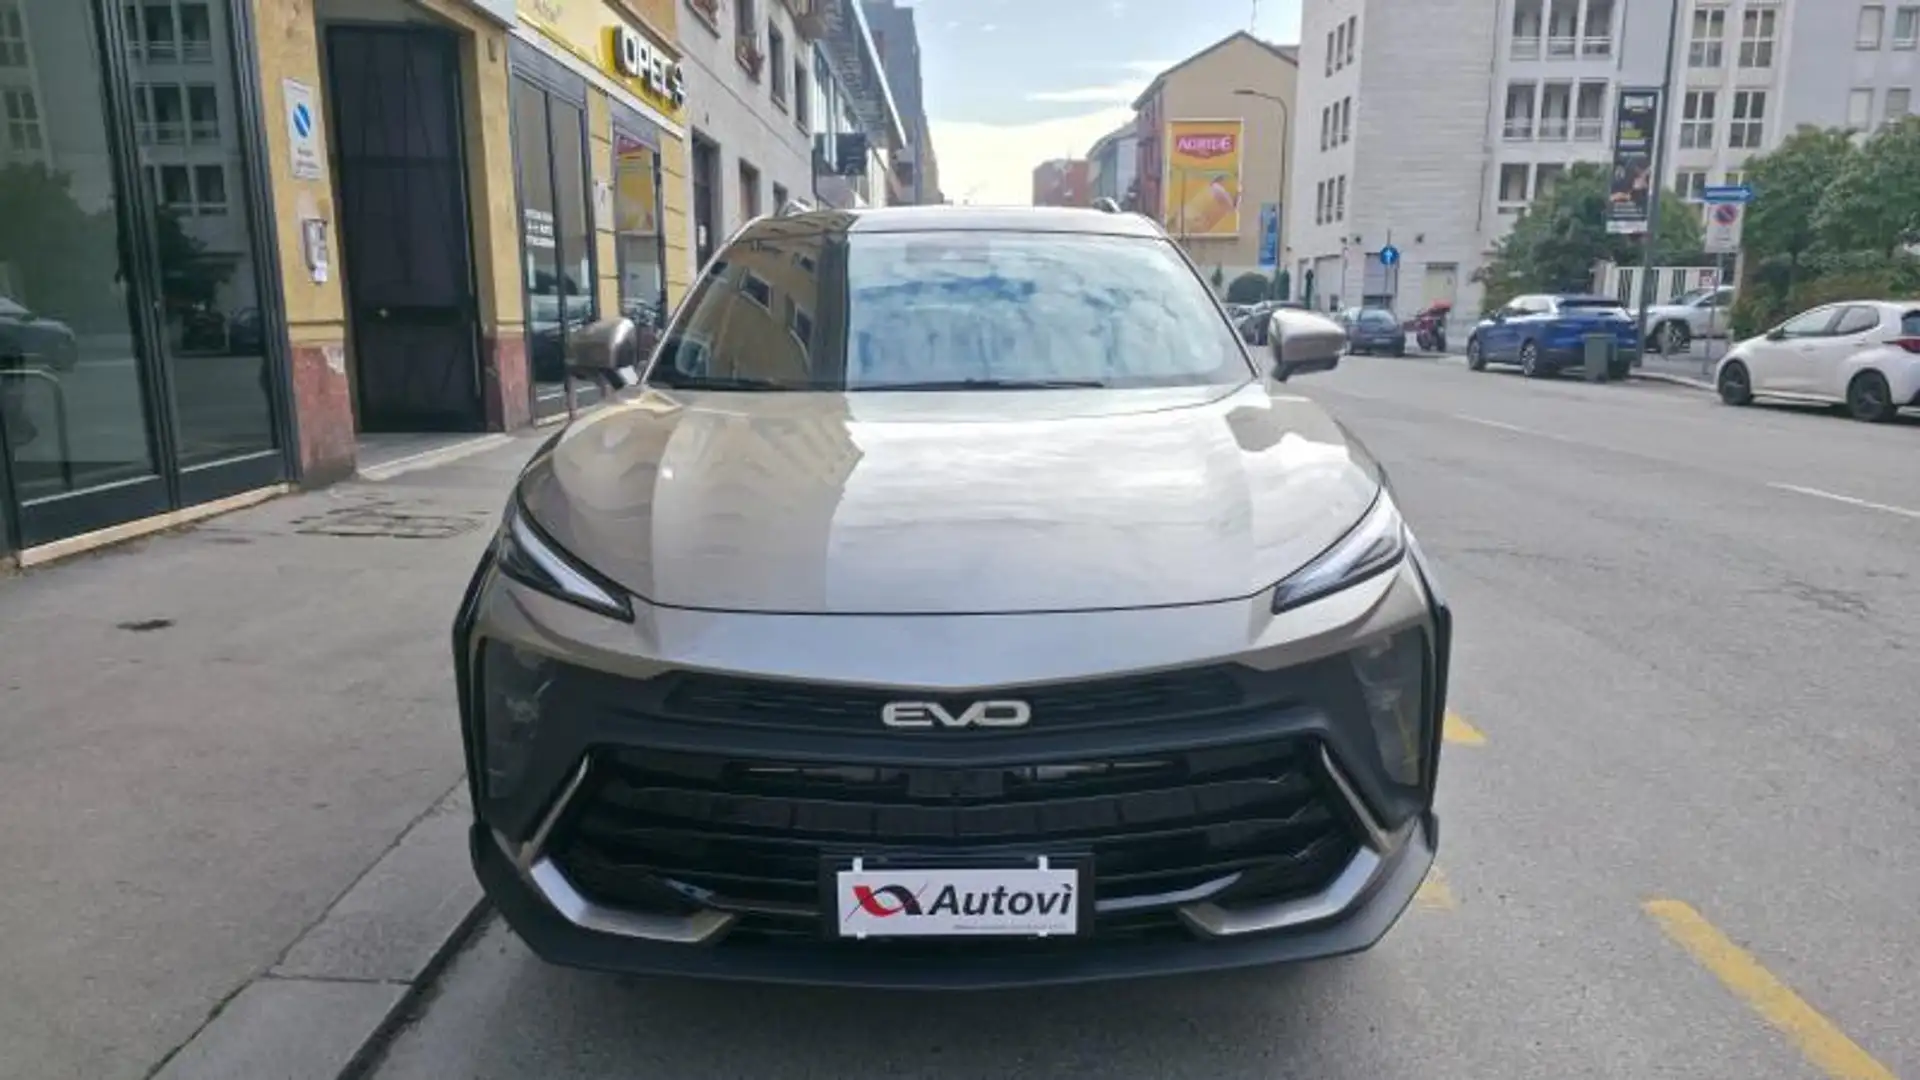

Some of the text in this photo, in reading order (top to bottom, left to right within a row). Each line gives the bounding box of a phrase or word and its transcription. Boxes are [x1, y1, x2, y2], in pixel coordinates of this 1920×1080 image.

[616, 22, 672, 100] OPEL
[882, 701, 1031, 727] EVO
[928, 883, 1073, 917] Autovì
